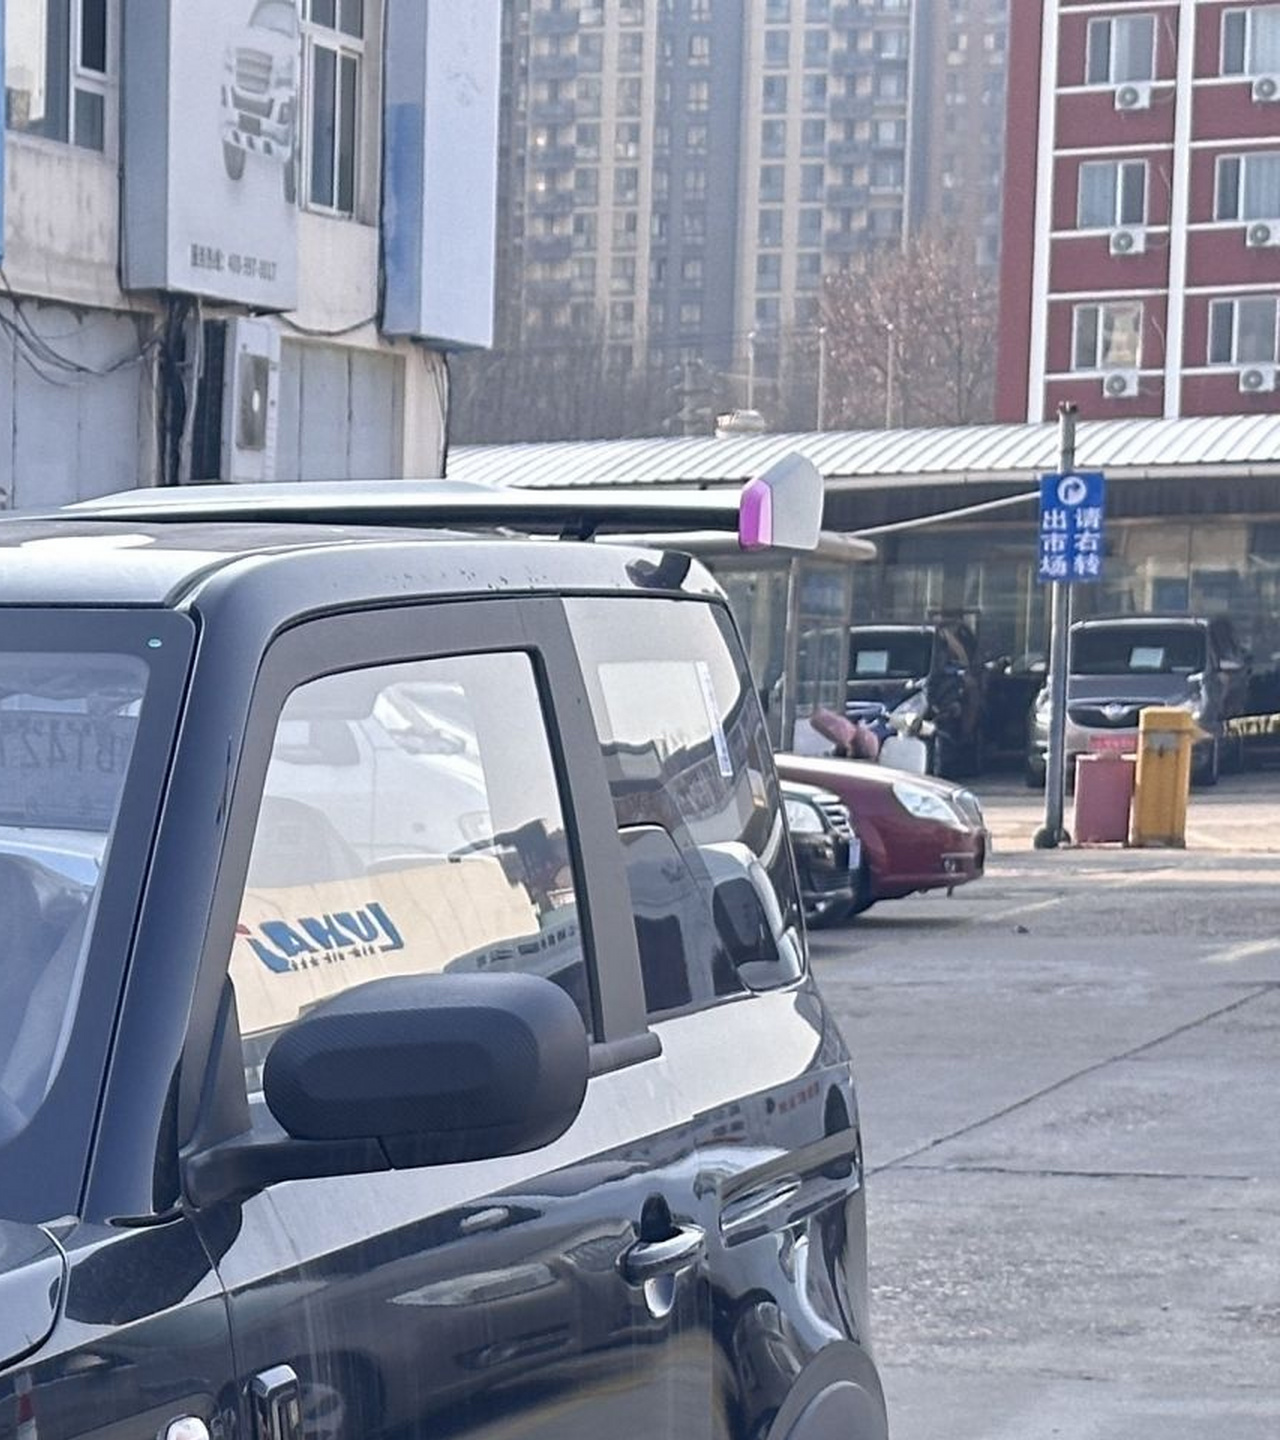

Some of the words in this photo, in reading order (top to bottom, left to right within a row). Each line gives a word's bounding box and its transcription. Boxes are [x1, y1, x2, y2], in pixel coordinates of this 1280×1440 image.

[1040, 508, 1068, 576] 出市场
[1074, 507, 1102, 575] 请右转
